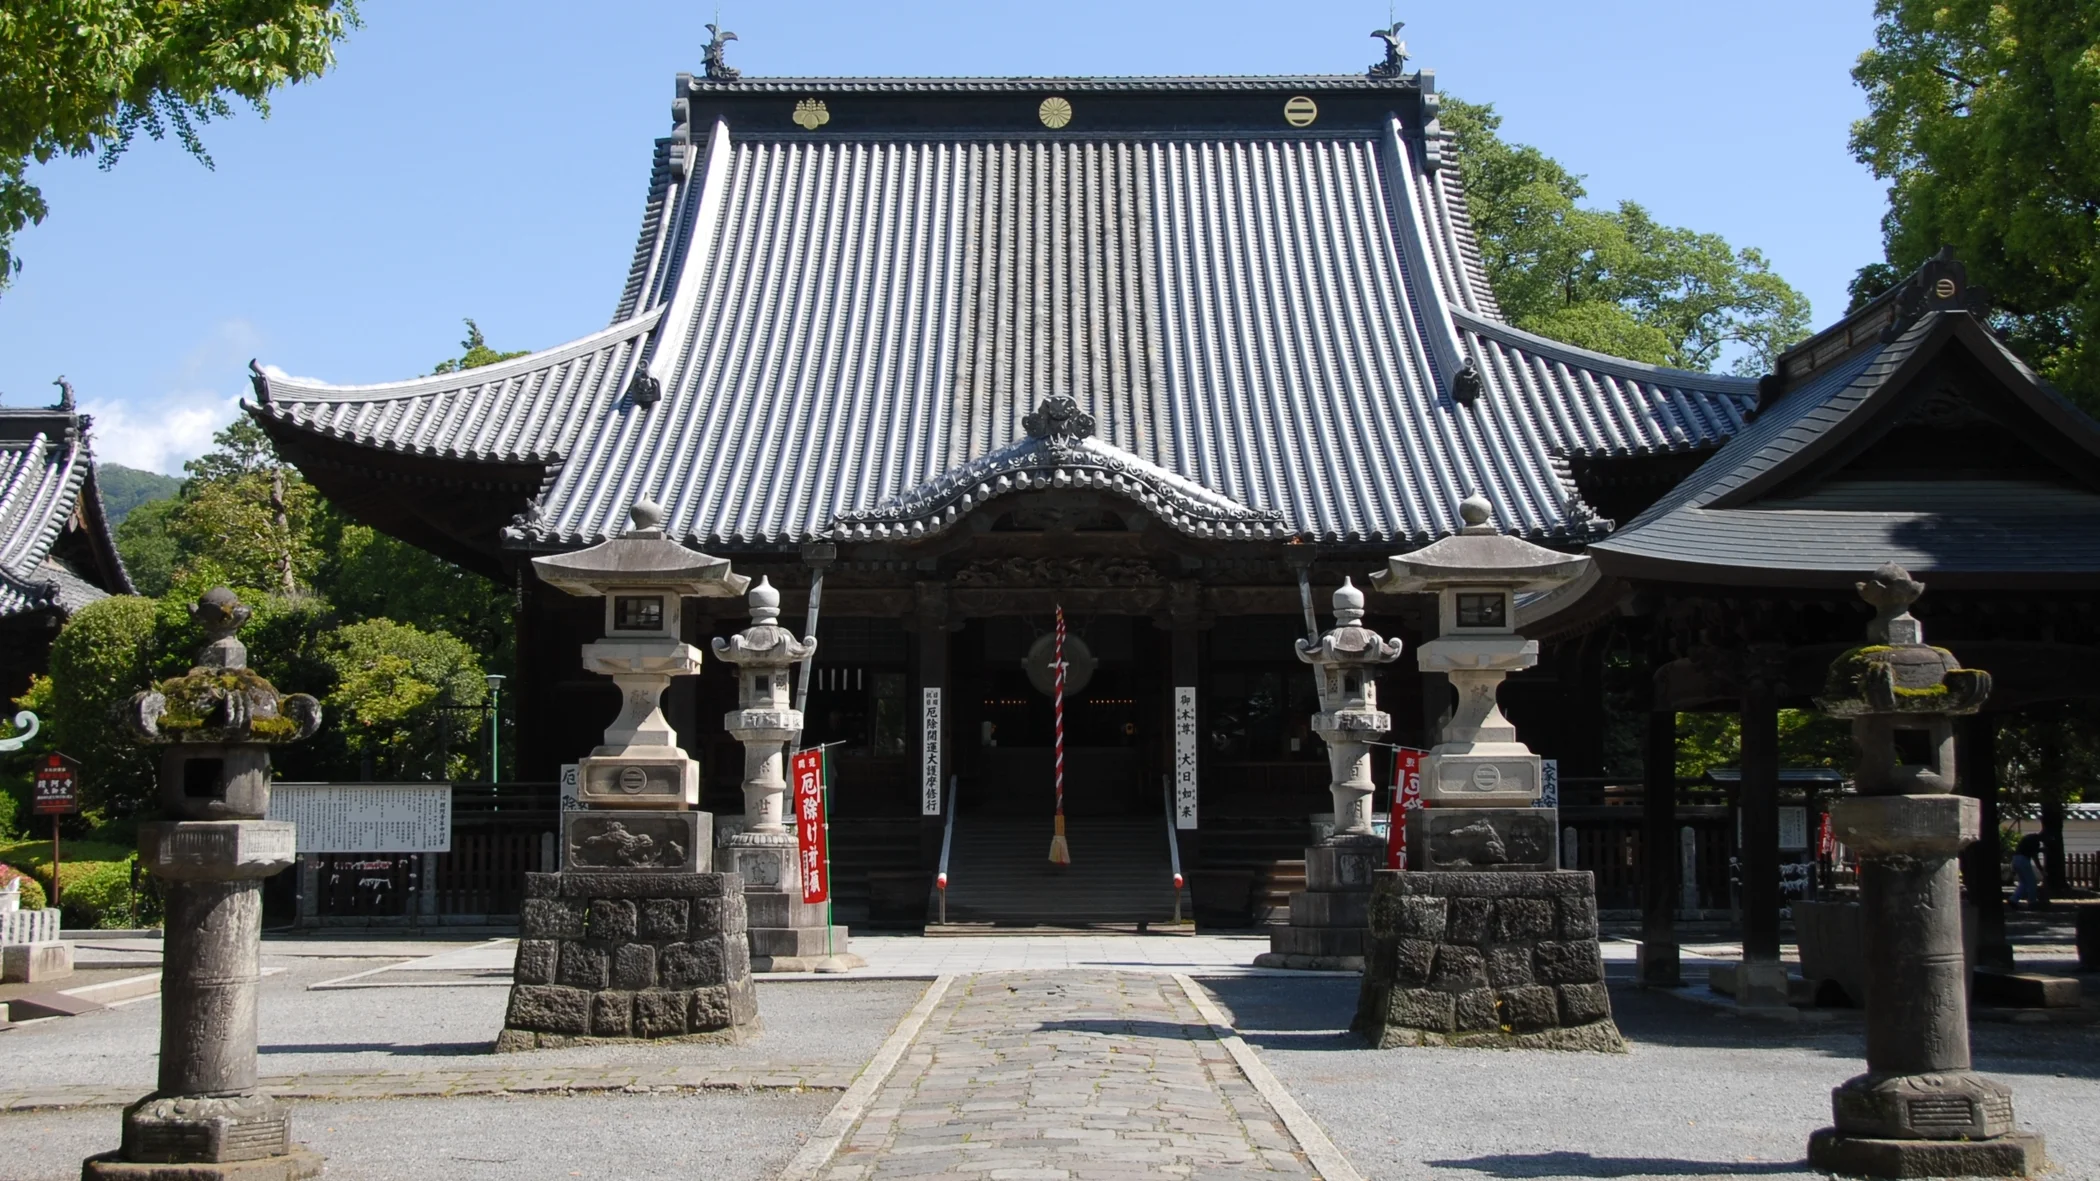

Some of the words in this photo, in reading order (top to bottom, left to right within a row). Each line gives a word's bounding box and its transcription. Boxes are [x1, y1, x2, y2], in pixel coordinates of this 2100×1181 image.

[1180, 695, 1191, 735] 御本尊
[926, 707, 938, 811] 厄除開運大護摩修行
[1181, 753, 1193, 818] 大日如来
[801, 772, 820, 893] 厄除け祈願
